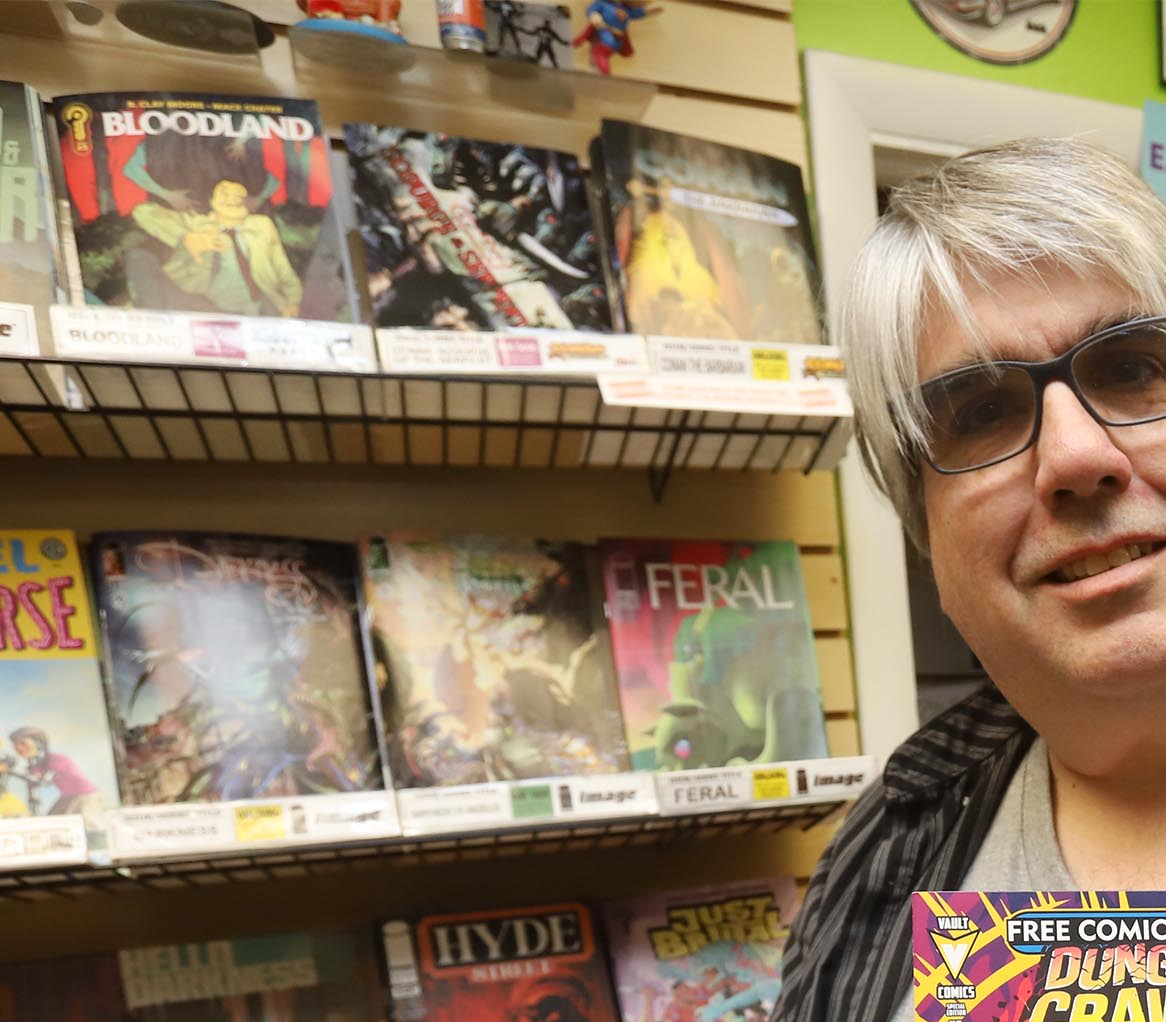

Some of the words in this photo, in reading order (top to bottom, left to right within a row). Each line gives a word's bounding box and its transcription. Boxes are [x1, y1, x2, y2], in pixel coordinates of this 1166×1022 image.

[102, 111, 314, 142] BLOODLAND
[645, 562, 796, 611] FERAL
[673, 784, 740, 803] FERAL
[937, 917, 969, 930] VAULT
[1007, 918, 1071, 943] FREE
[434, 914, 582, 967] HYDE
[937, 985, 976, 999] COMICS
